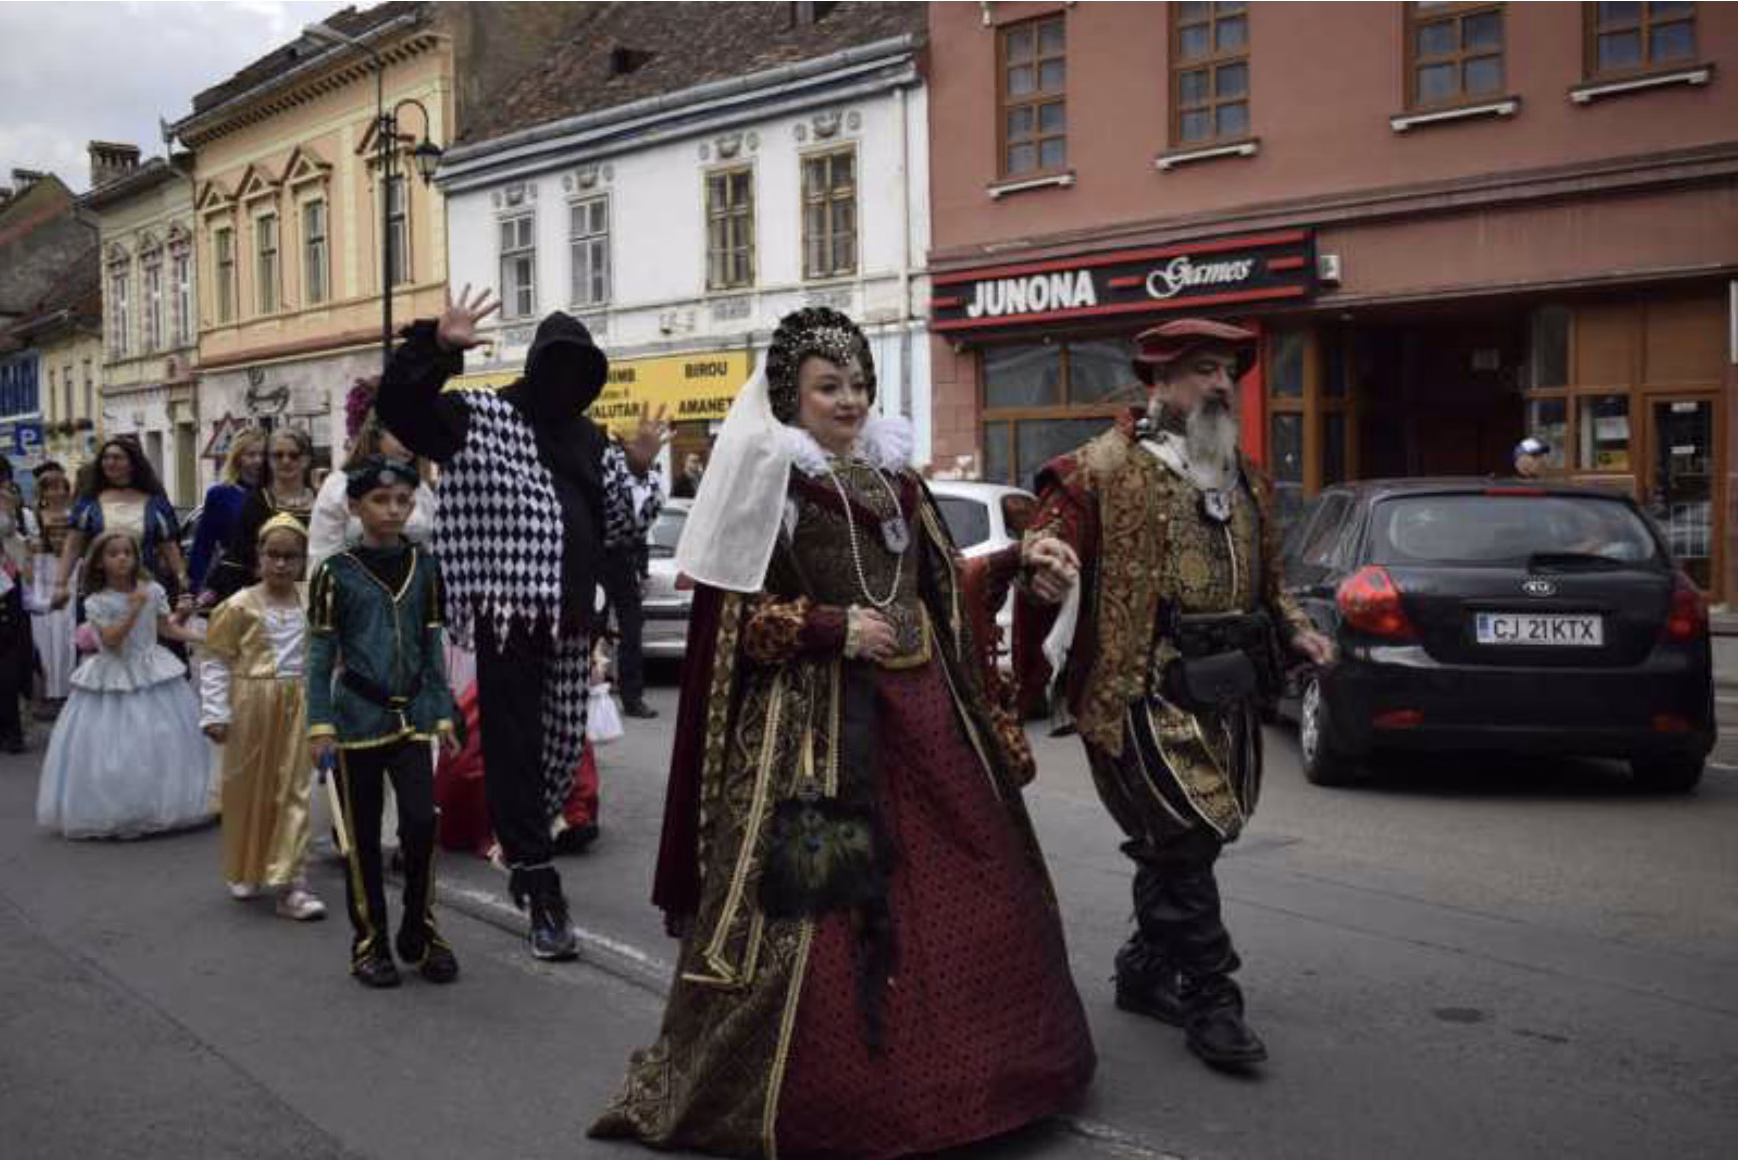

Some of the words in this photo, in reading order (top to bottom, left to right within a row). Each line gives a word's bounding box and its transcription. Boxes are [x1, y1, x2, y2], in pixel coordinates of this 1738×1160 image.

[967, 270, 1097, 317] JUNONA
[685, 362, 728, 379] BIROU
[21, 429, 37, 450] P
[1494, 617, 1519, 639] CJ
[1529, 619, 1547, 639] 21
[1552, 619, 1593, 639] KTX
